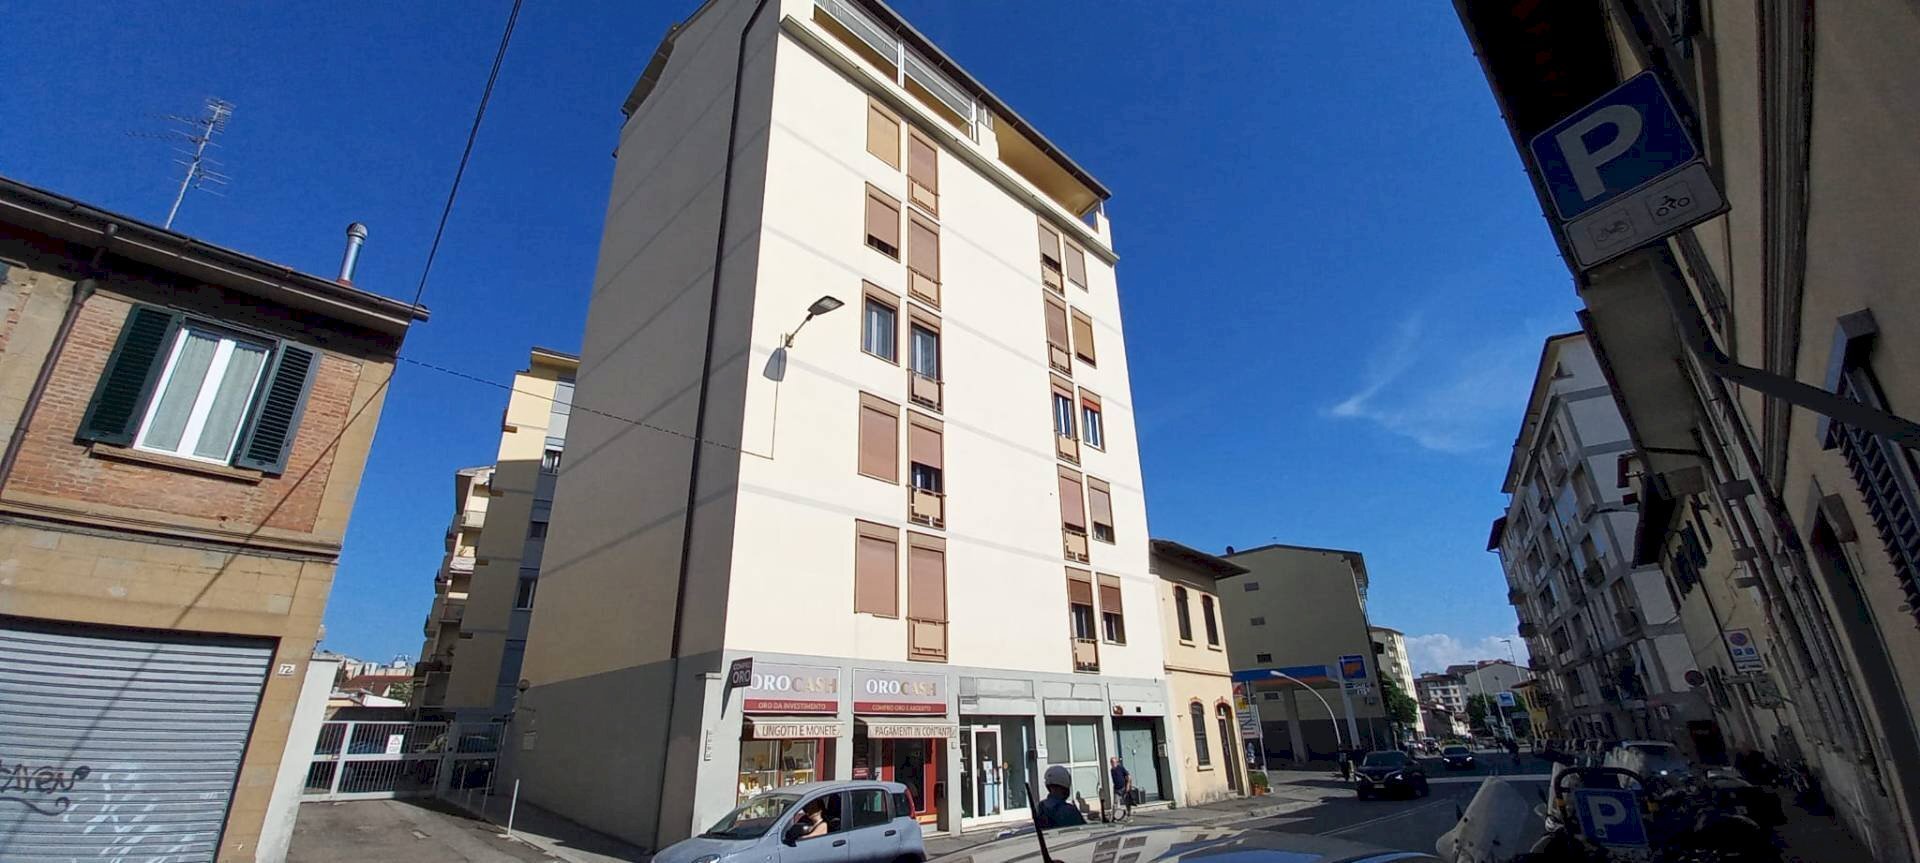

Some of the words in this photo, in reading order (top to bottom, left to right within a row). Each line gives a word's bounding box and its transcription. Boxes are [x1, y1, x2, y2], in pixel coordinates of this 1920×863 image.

[1555, 104, 1643, 202] P
[732, 670, 751, 684] ORO
[773, 702, 782, 710] DA
[762, 725, 798, 736] LINGOTTI
[799, 725, 805, 736] E
[806, 725, 837, 736] MONETE
[875, 726, 913, 737] PAGAMENTI
[914, 726, 921, 736] IN
[1587, 796, 1627, 838] P
